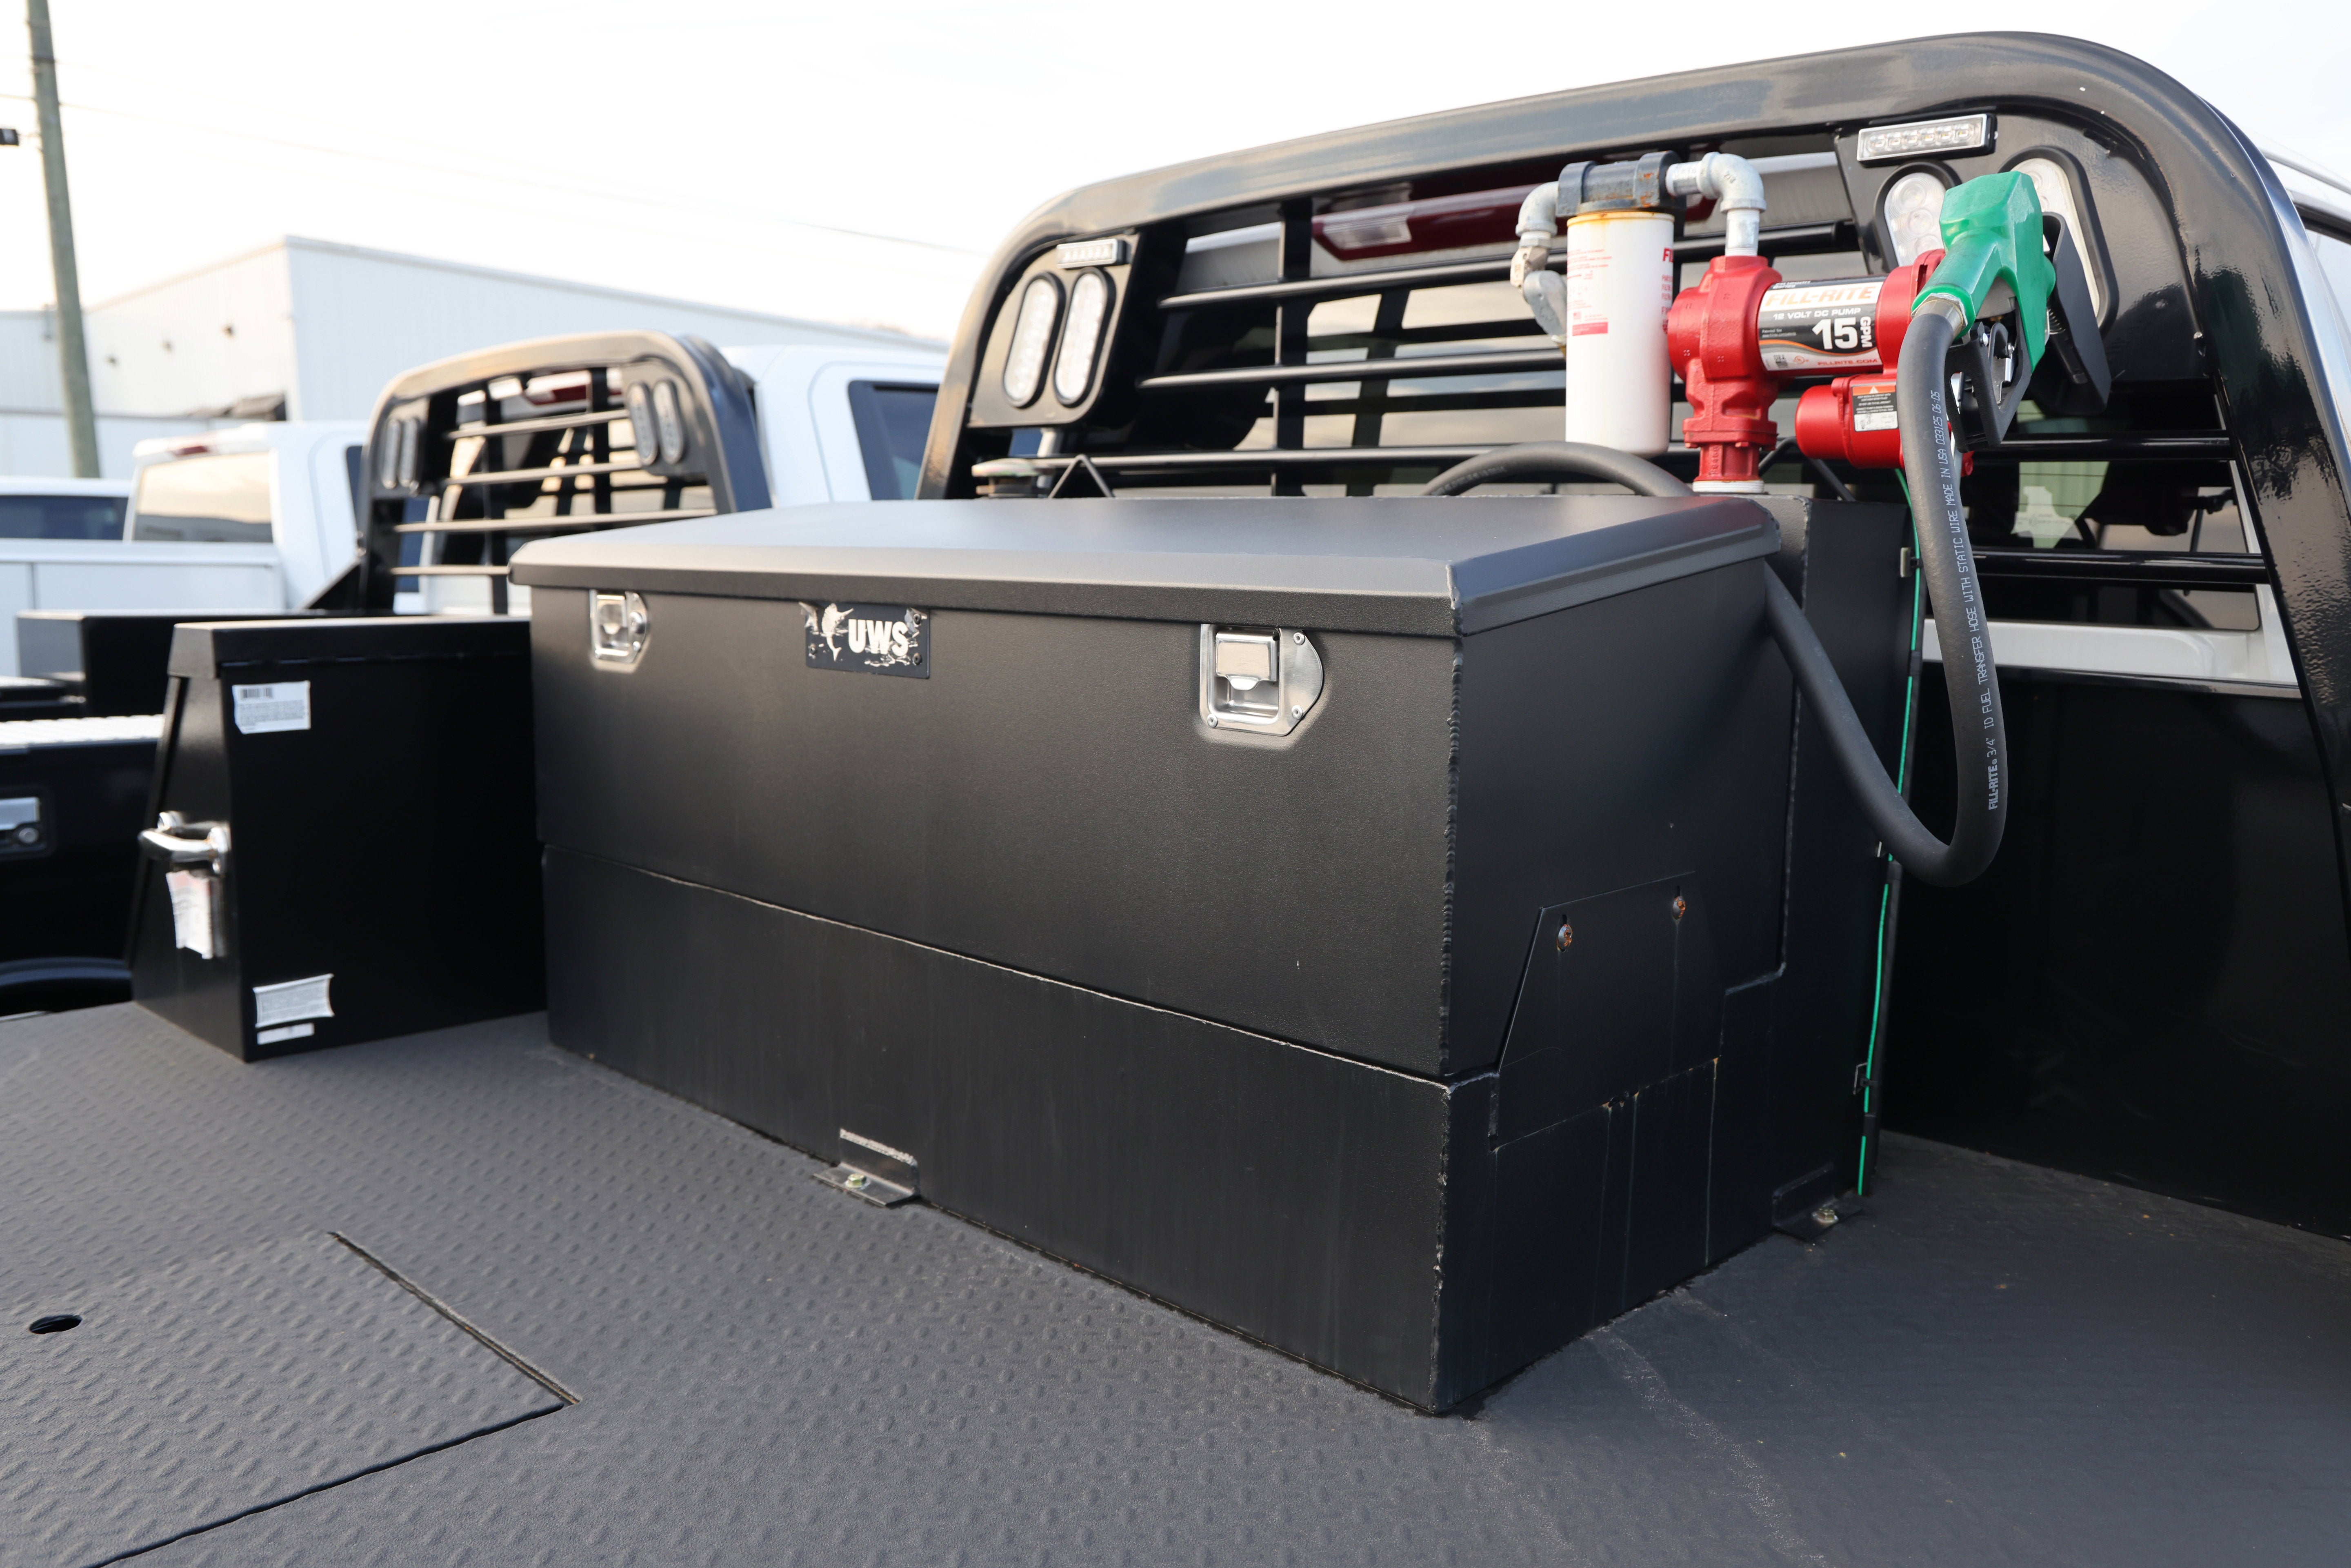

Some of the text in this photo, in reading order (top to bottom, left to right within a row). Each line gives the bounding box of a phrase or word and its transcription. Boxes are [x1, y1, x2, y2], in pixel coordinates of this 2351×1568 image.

[1765, 286, 1877, 306] FILL-RITE
[1787, 311, 1812, 320] VOLT
[1831, 307, 1861, 316] PUMP
[1812, 317, 1858, 350] 15
[1860, 316, 1873, 348] GPM
[1931, 390, 1941, 413] 06:05
[1933, 415, 1945, 445] 033125
[1937, 449, 1948, 464] USA
[1940, 468, 1951, 478] IN
[1942, 483, 1956, 506] MADE
[1947, 510, 1961, 533] WIRE
[1953, 537, 1968, 573] STATIC
[1960, 577, 1974, 602] WITH
[1966, 606, 1980, 632] HOSE
[848, 618, 909, 657] UWS
[1971, 635, 1988, 685] TRANSFER
[1980, 688, 1992, 714] FUEL
[1984, 717, 1994, 729] ID
[1986, 738, 1997, 757] 3/4"
